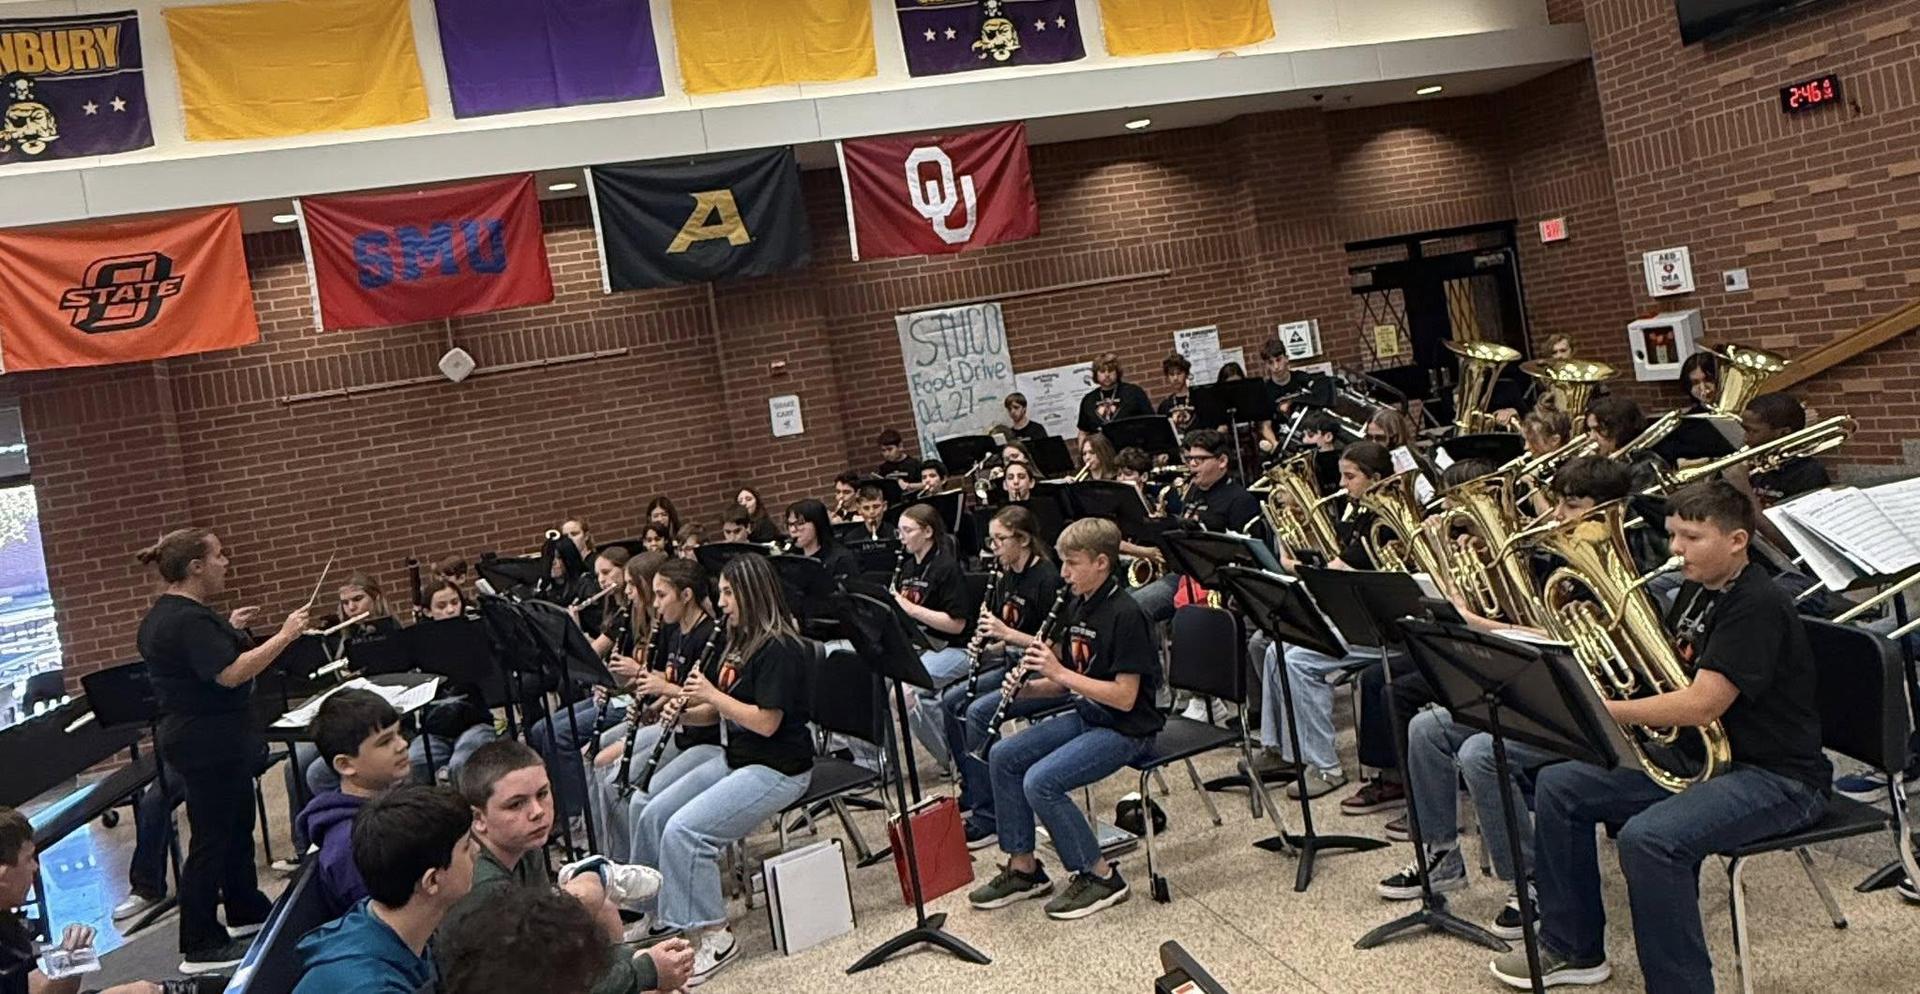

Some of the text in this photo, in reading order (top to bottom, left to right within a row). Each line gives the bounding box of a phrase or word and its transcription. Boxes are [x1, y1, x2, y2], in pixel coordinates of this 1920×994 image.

[1790, 82, 1821, 107] 2:46
[904, 146, 977, 244] OU
[667, 189, 751, 254] A
[353, 219, 507, 289] SMU
[1659, 252, 1676, 261] AED
[60, 275, 184, 309] STATE
[909, 304, 1001, 367] STUCO
[911, 364, 955, 396] Food
[958, 358, 1006, 384] Drive
